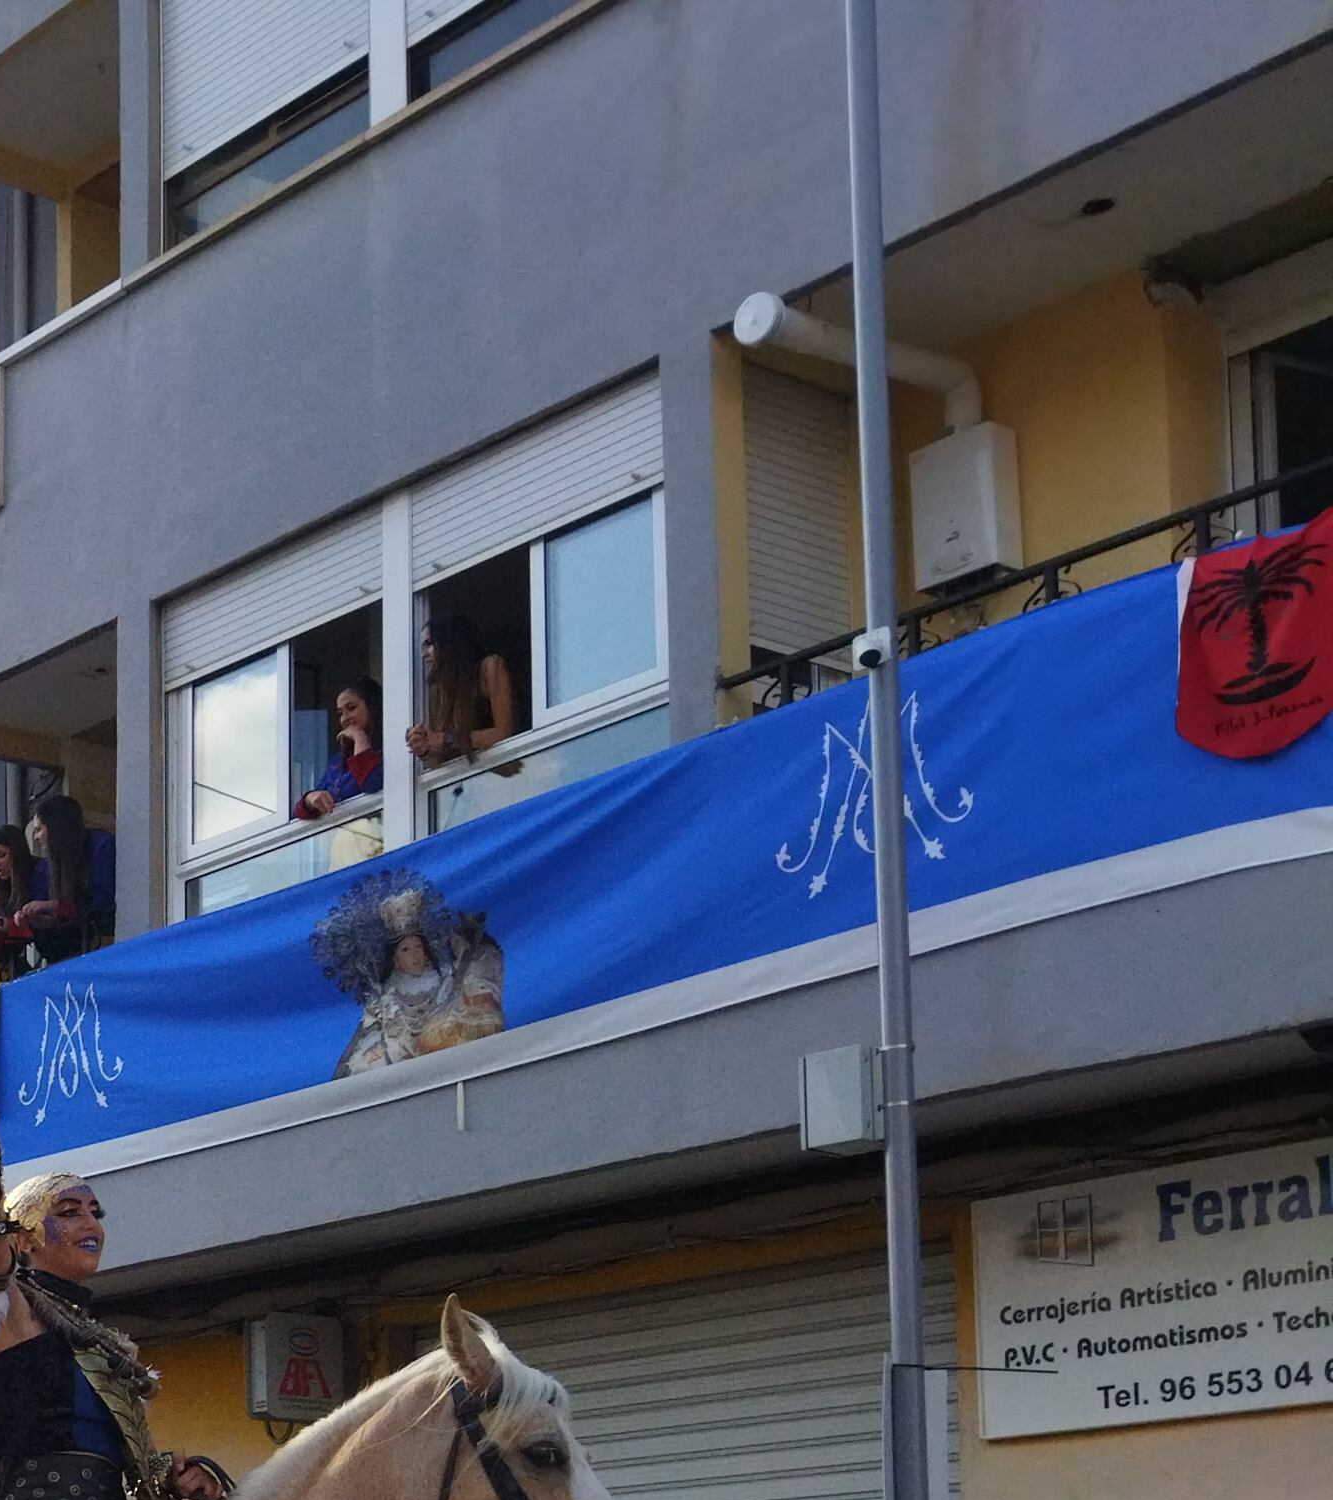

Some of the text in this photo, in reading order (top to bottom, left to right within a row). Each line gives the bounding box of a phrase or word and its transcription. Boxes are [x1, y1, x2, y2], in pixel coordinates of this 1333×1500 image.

[1156, 1154, 1333, 1242] Ferral
[999, 1291, 1112, 1326] Cerrajería
[1120, 1278, 1218, 1310] Artística
[1004, 1305, 1333, 1369] P.V.C Automatismos Tech
[1097, 1382, 1149, 1410] Tel.
[1160, 1376, 1196, 1404] 96
[1207, 1367, 1264, 1398] 553
[1274, 1361, 1314, 1390] 04
